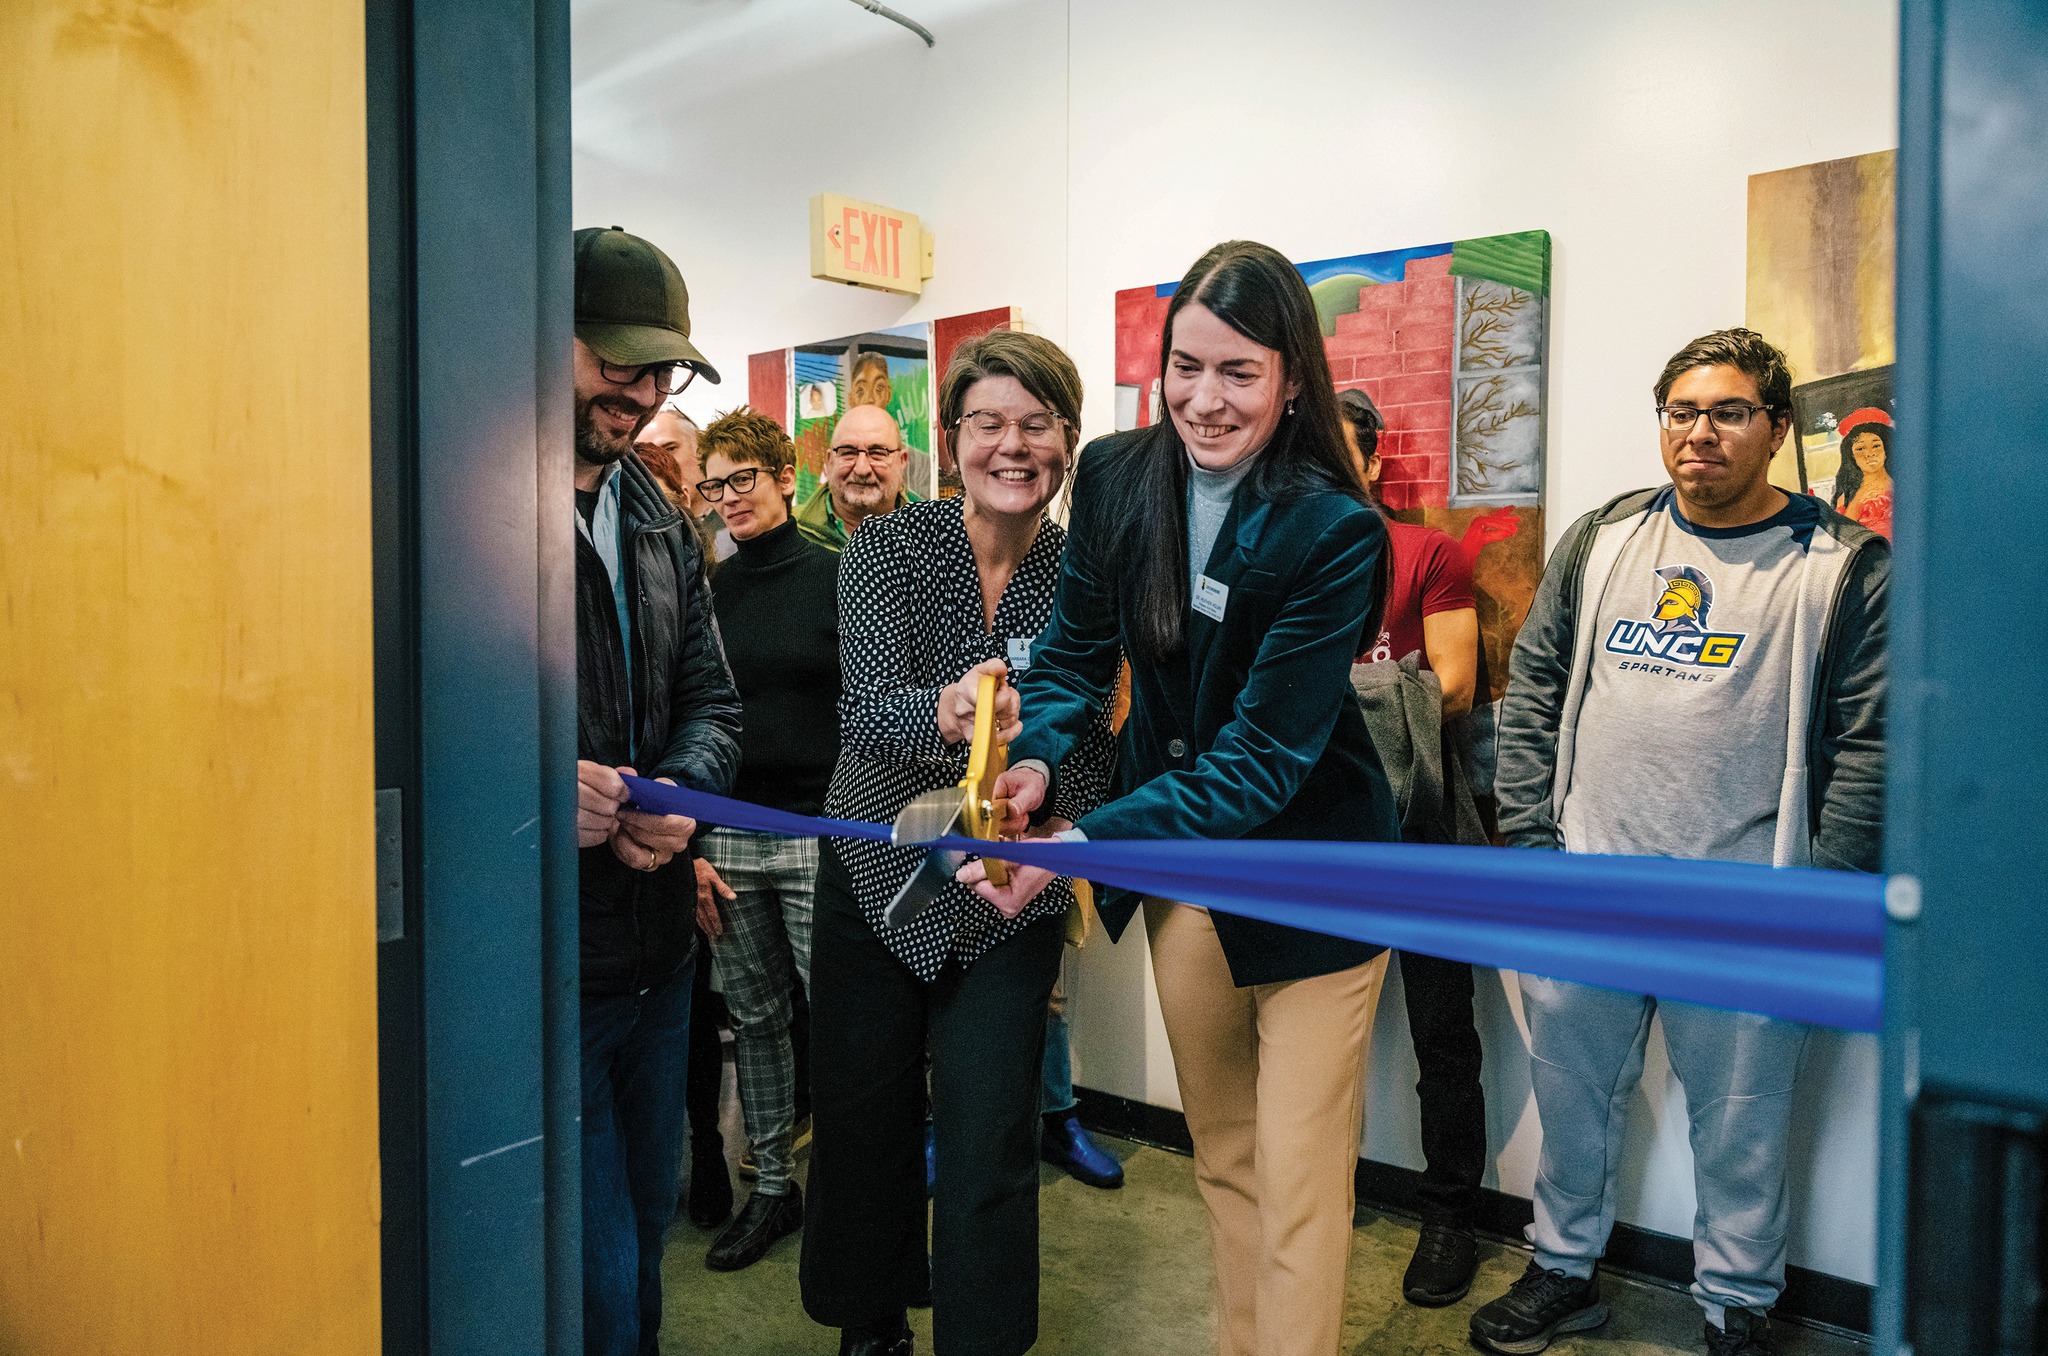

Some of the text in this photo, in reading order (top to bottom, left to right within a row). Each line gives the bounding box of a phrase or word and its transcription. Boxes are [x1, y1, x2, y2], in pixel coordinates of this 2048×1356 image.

[843, 206, 903, 279] EXIT
[1607, 620, 1744, 667] UNCG
[1618, 661, 1717, 683] SPARTANS
